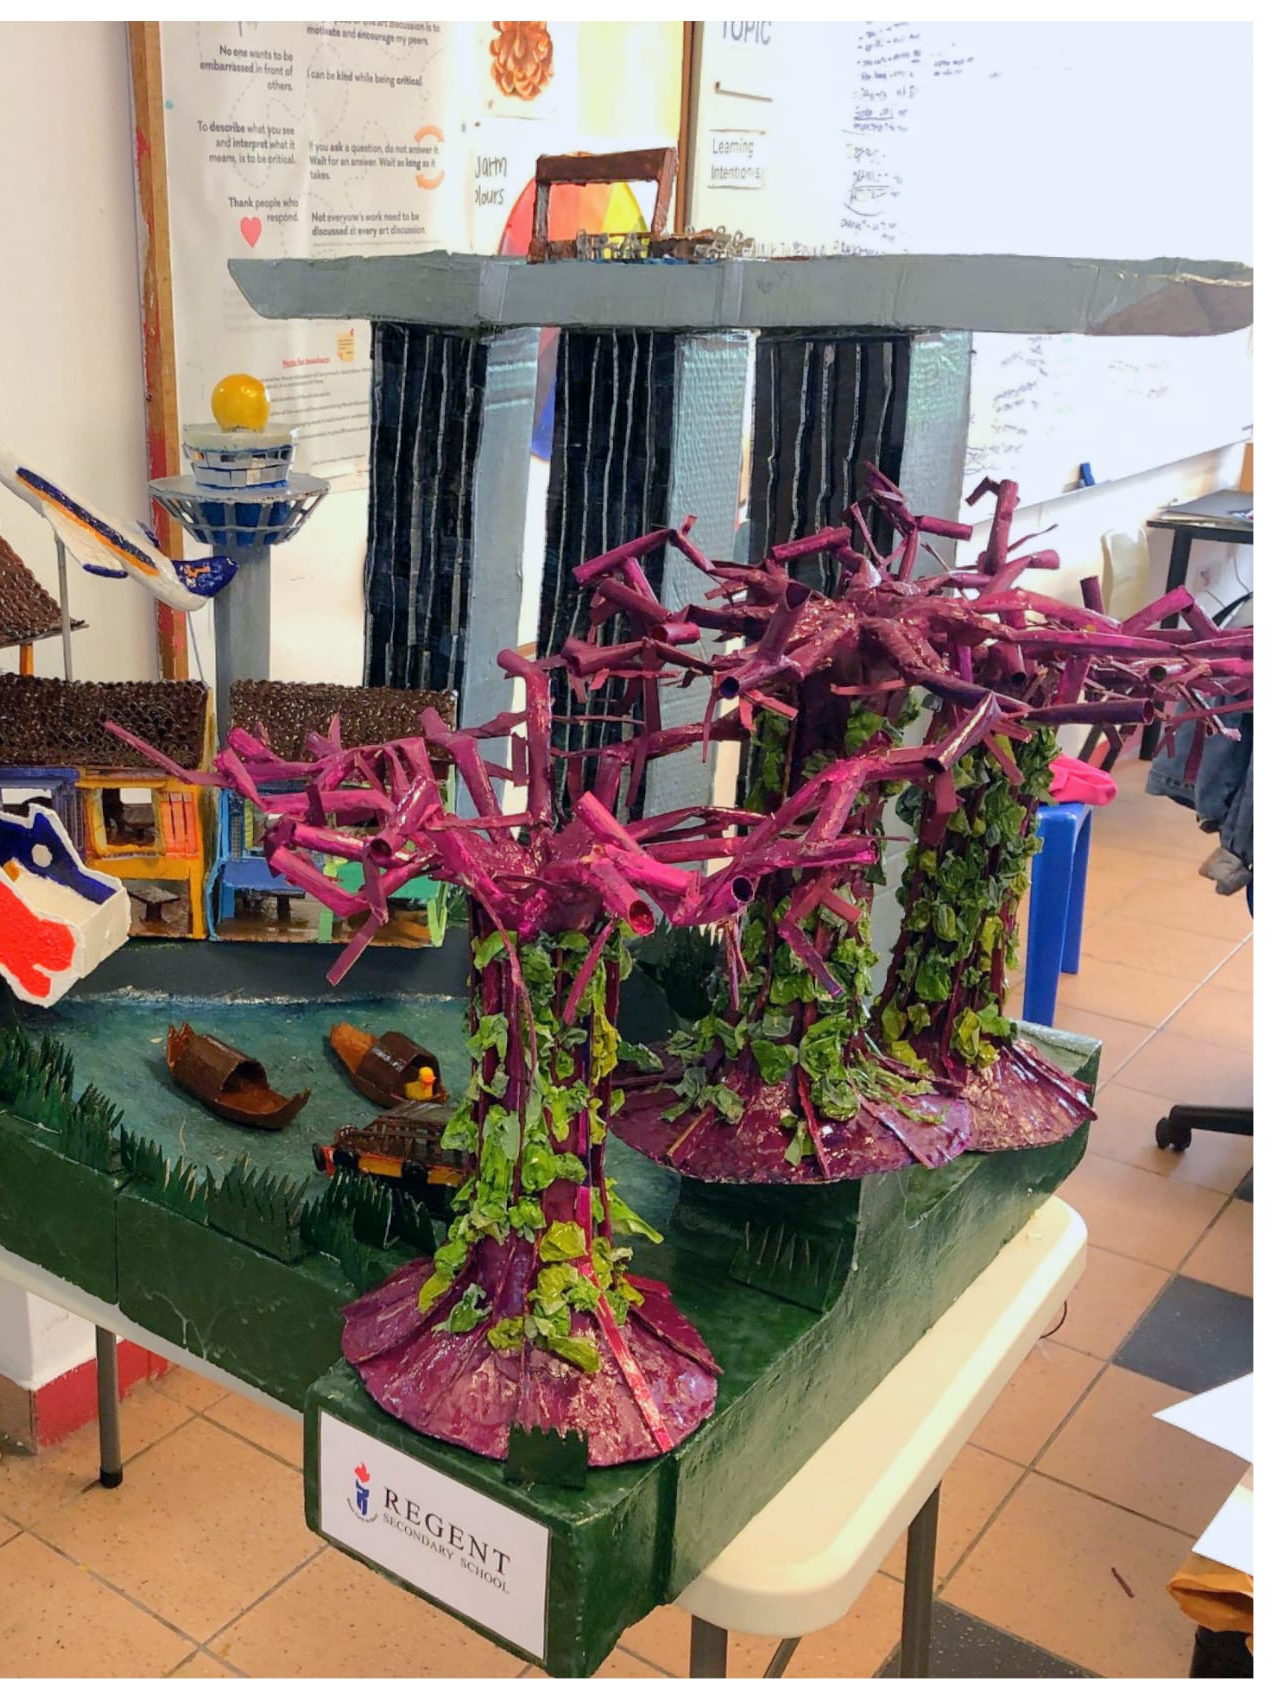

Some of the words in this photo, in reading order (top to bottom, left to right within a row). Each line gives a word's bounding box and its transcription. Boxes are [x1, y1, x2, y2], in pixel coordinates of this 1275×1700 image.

[433, 23, 441, 32] to
[307, 26, 341, 37] motivate
[342, 28, 356, 38] and
[357, 32, 394, 45] encourage
[396, 36, 406, 46] my
[219, 45, 232, 56] No
[234, 48, 247, 57] one
[250, 50, 272, 60] wants
[273, 51, 282, 60] to
[284, 50, 293, 62] be
[200, 60, 253, 73] embarrassed
[256, 64, 263, 73] in
[264, 64, 283, 75] front
[285, 66, 293, 76] of
[268, 80, 293, 91] others.
[311, 71, 325, 80] can
[327, 70, 335, 80] be
[337, 71, 353, 81] kind
[355, 72, 373, 83] while
[375, 73, 395, 88] being
[197, 121, 208, 132] To
[210, 121, 245, 133] describe
[247, 123, 265, 133] what
[268, 126, 281, 138] you
[216, 137, 231, 148] and
[233, 137, 268, 151] interpret
[270, 140, 288, 149] what
[289, 140, 295, 150] it
[315, 144, 328, 154] you
[330, 142, 343, 152] ask
[351, 144, 383, 156] question,
[385, 142, 394, 153] do
[396, 145, 407, 154] not
[409, 146, 432, 154] answer
[712, 138, 754, 158] Learning
[209, 154, 237, 164] means,
[239, 154, 245, 163] is
[247, 154, 255, 163] to
[257, 154, 265, 163] be
[310, 156, 325, 166] Wait
[329, 156, 339, 166] for
[379, 157, 395, 167] Wait
[397, 159, 404, 167] as
[406, 157, 421, 170] long
[229, 197, 253, 208] Thank
[255, 197, 281, 211] people
[283, 197, 299, 207] who
[312, 212, 325, 222] Not
[327, 213, 364, 224] everyone's
[366, 211, 382, 221] work
[384, 211, 401, 221] need
[403, 213, 409, 221] to
[411, 211, 420, 221] be
[312, 226, 348, 236] discussed
[350, 227, 357, 235] at
[358, 227, 377, 238] every
[379, 226, 389, 235] art
[383, 1486, 511, 1576] REGENT
[383, 1513, 454, 1561] SECONDARY
[460, 1557, 510, 1594] SCHOOL
